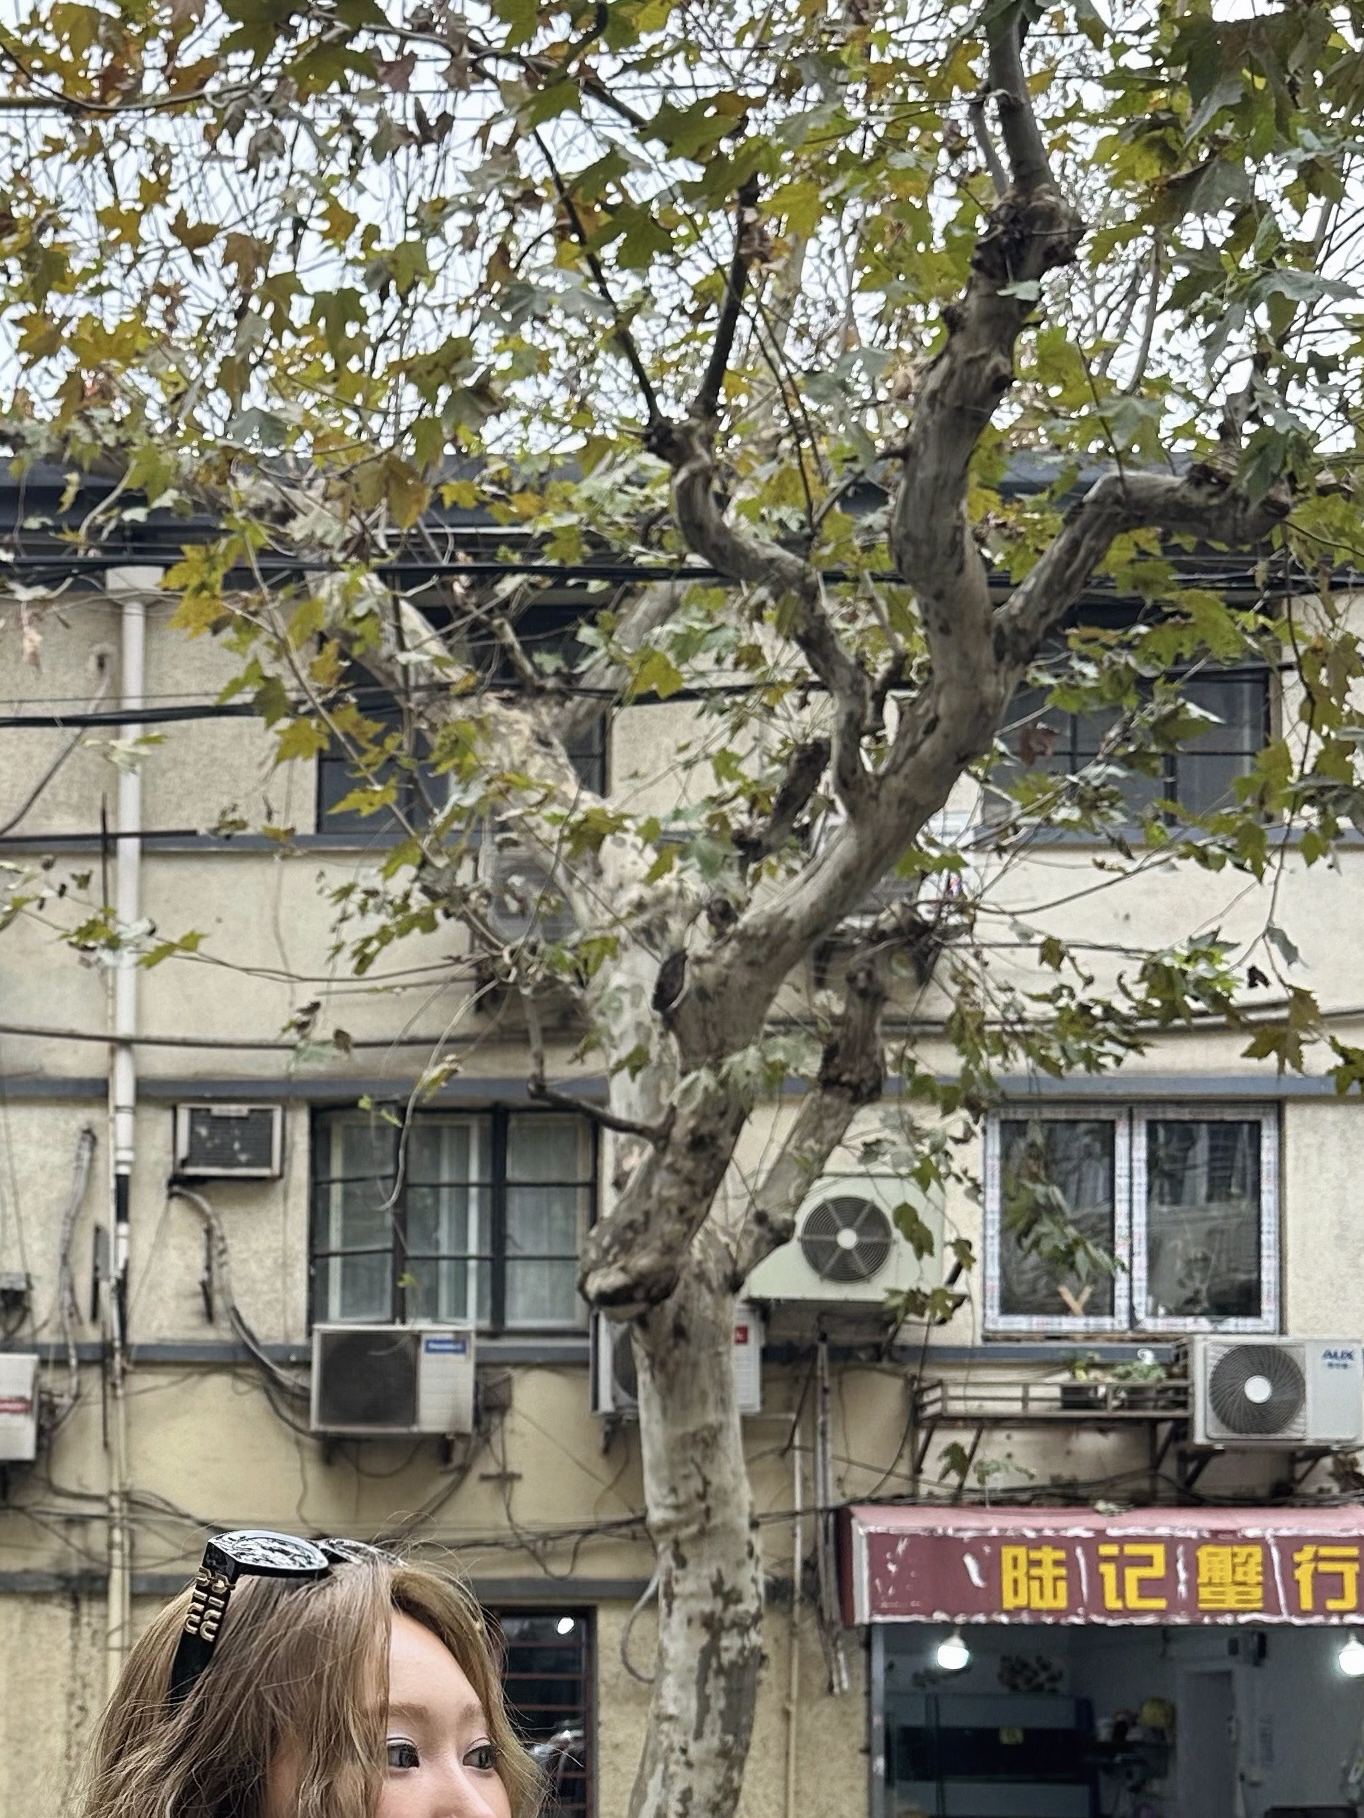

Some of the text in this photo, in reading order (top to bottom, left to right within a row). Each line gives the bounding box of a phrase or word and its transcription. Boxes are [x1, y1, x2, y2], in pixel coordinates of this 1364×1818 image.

[1322, 1349, 1354, 1361] AUX
[1000, 1542, 1361, 1611] 陆记蟹行
